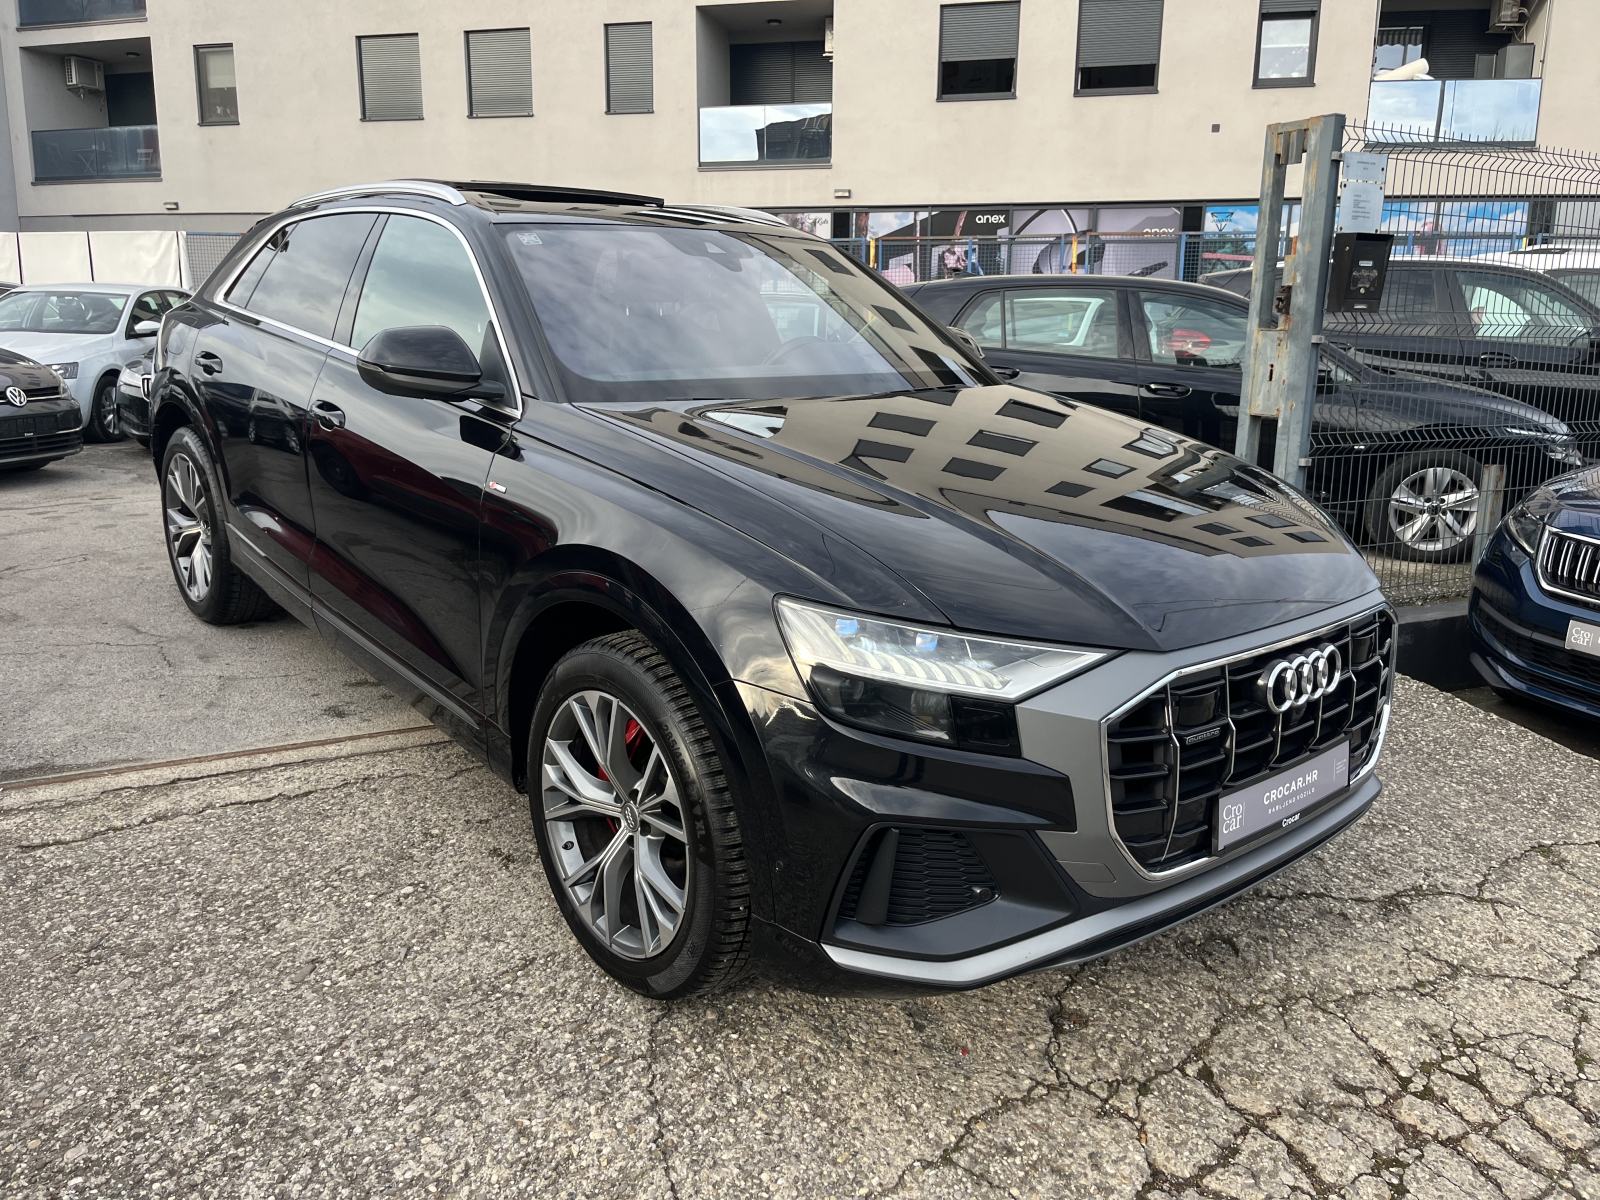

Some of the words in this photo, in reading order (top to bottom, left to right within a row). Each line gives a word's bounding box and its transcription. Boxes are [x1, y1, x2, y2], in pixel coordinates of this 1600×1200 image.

[975, 213, 1006, 224] anex
[1571, 635, 1590, 646] car
[1572, 627, 1591, 639] Cro
[1263, 769, 1318, 805] CROCAR.HR
[1223, 803, 1243, 821] Cro
[1281, 812, 1301, 828] Crocar
[1222, 815, 1243, 834] car
